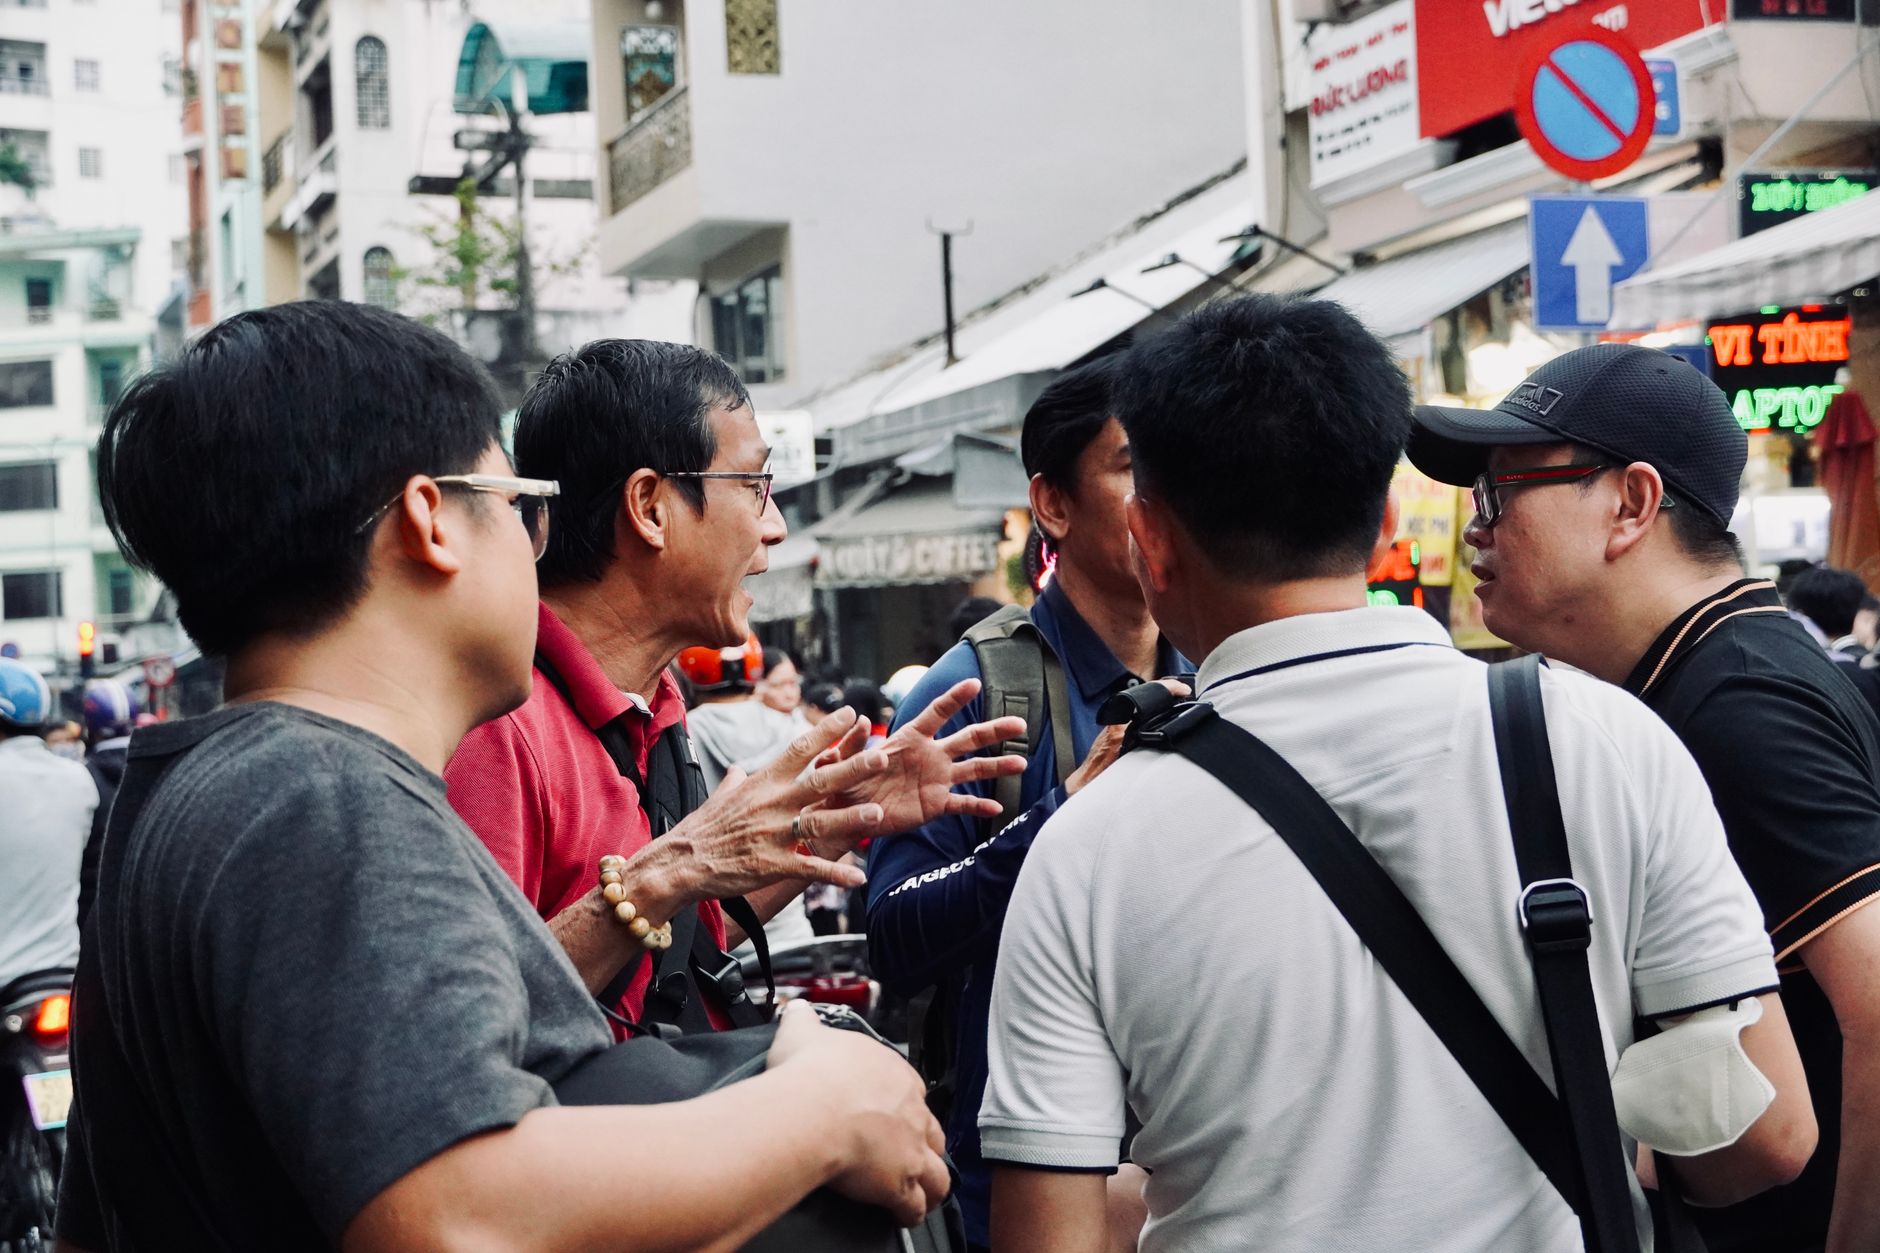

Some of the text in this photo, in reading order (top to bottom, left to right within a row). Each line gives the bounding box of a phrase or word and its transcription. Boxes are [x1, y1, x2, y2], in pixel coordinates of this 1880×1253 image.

[1709, 312, 1851, 367] VI TÍNH
[1510, 394, 1541, 412] adidas
[1732, 385, 1845, 430] APTO
